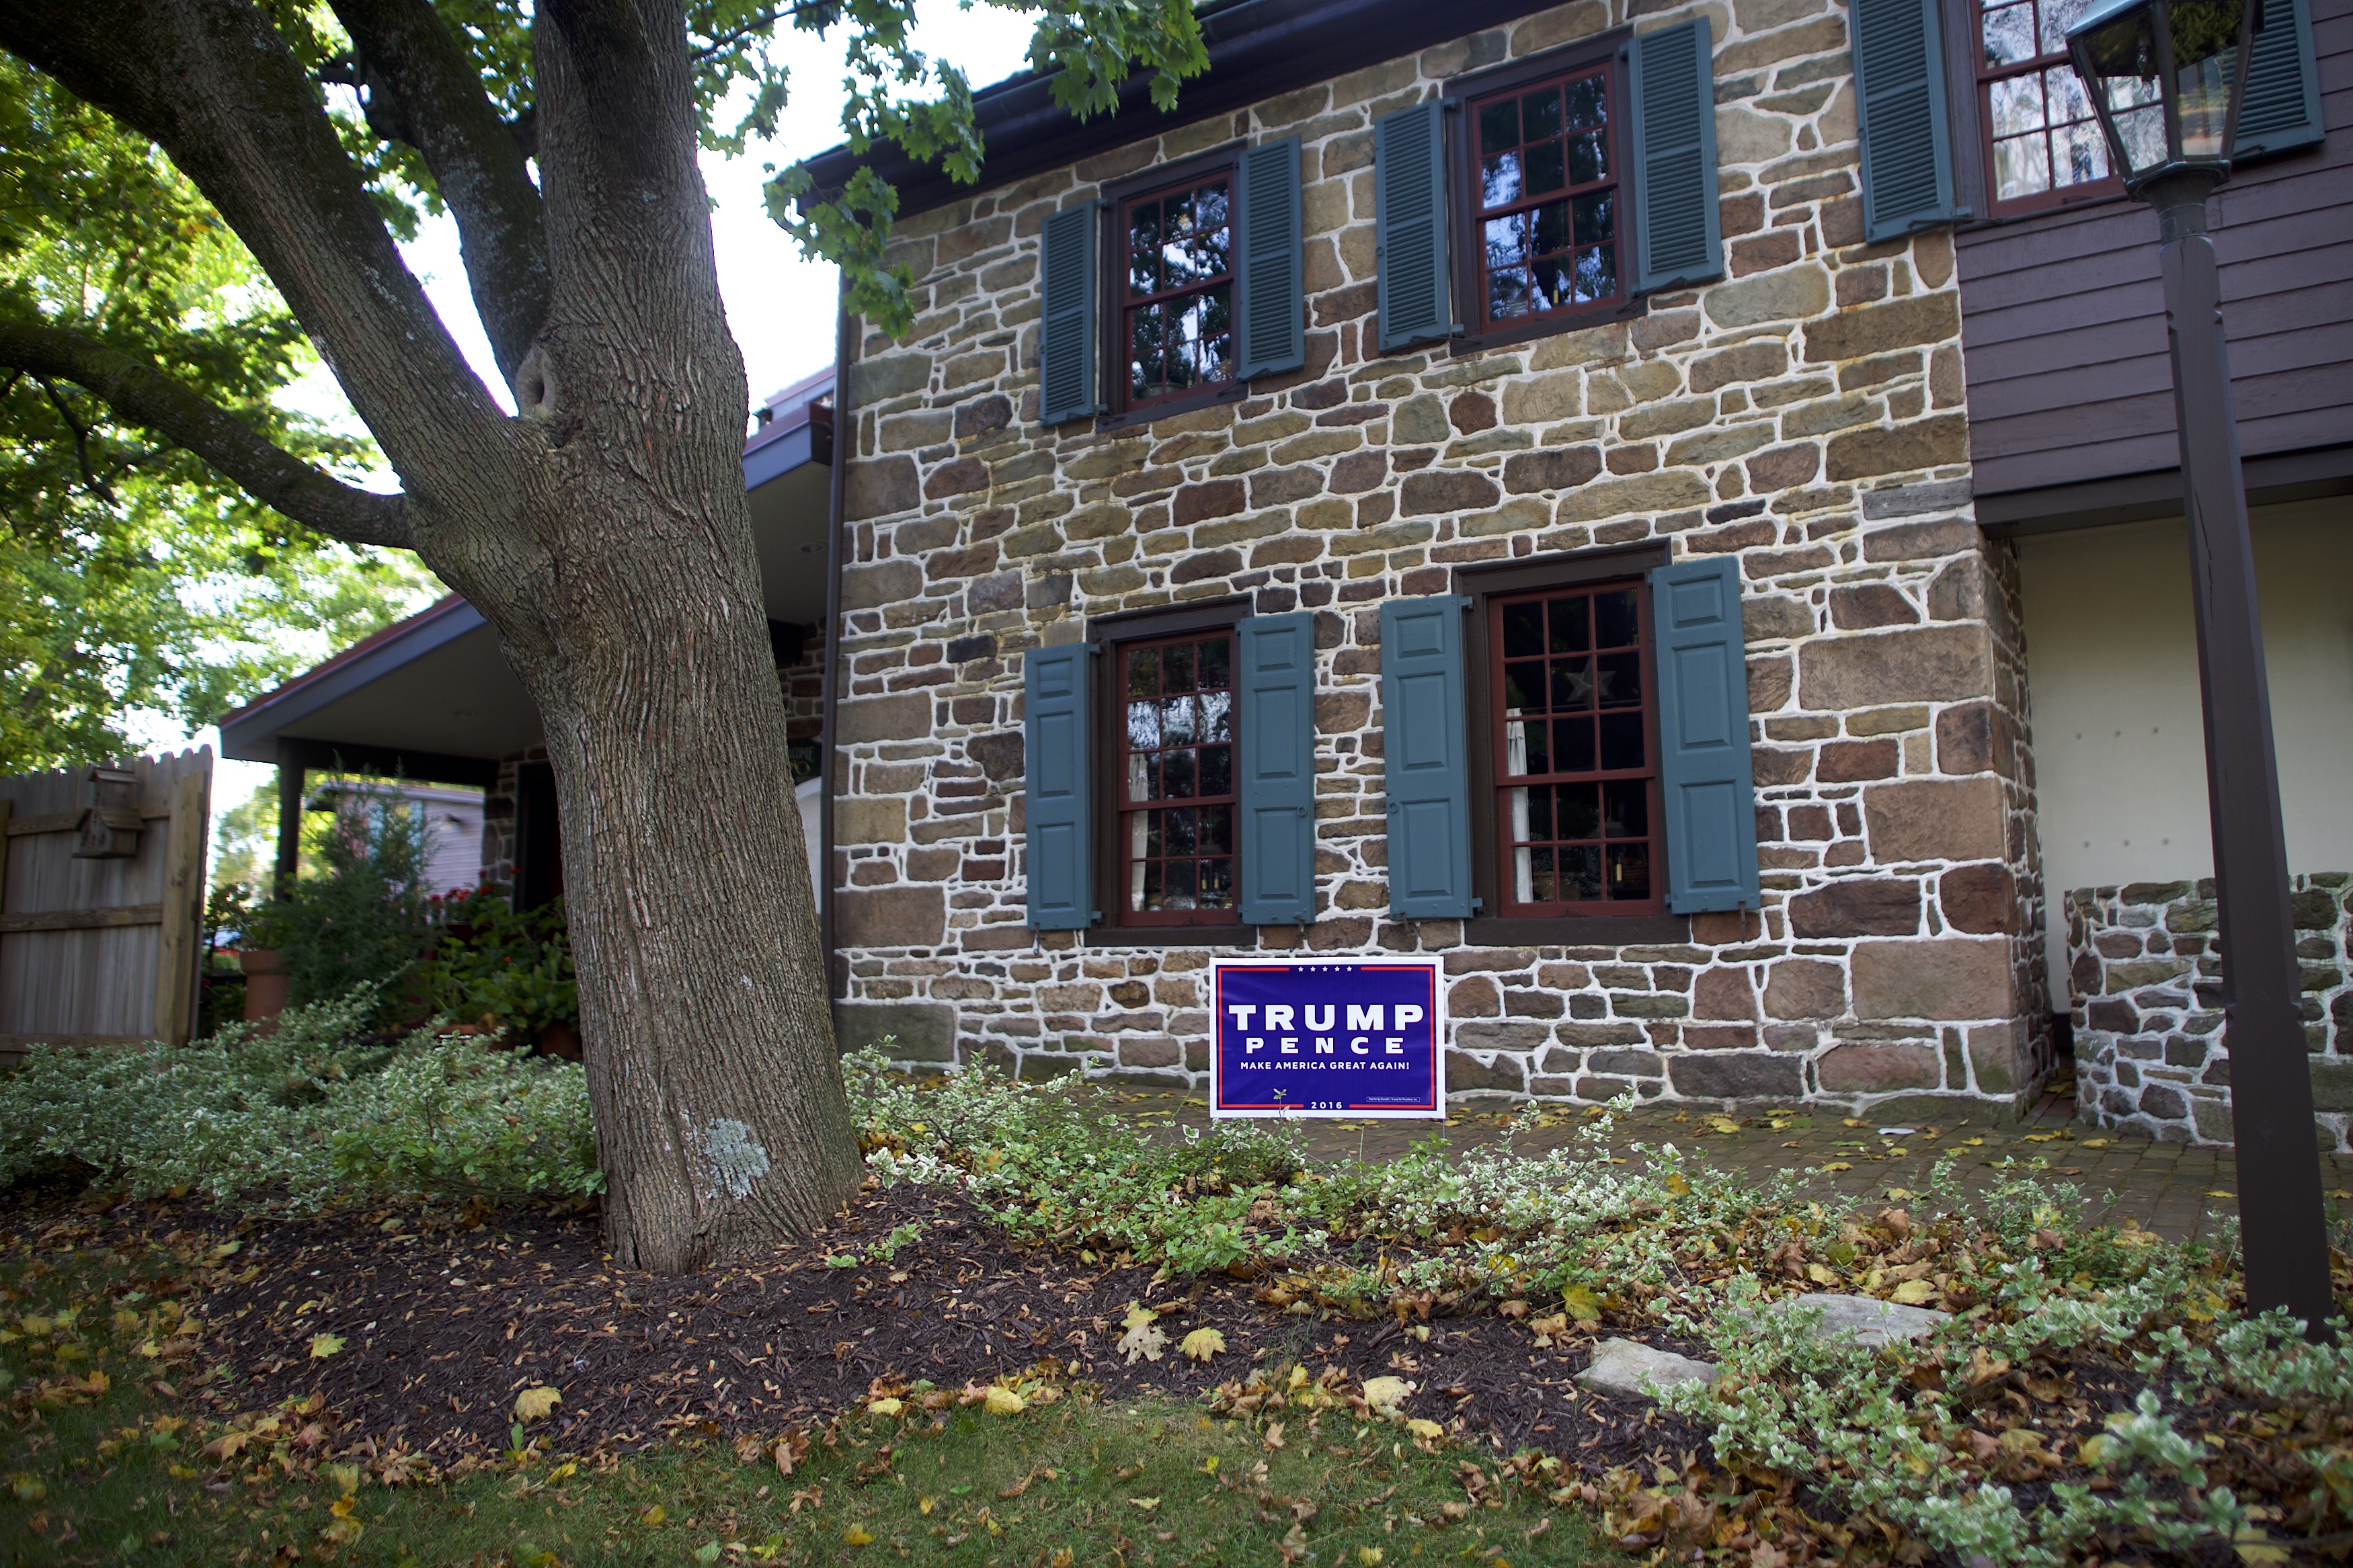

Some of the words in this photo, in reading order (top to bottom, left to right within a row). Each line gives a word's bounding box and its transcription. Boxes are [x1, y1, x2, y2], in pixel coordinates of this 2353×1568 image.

[1228, 1004, 1423, 1031] TRUMP
[1246, 1037, 1404, 1054] PENCE
[1240, 1061, 1271, 1070] MAKE
[1275, 1061, 1326, 1070] AMERICA
[1329, 1061, 1366, 1070] GREAT
[1369, 1061, 1410, 1070] AGAIN!
[1311, 1101, 1343, 1110] 2016
